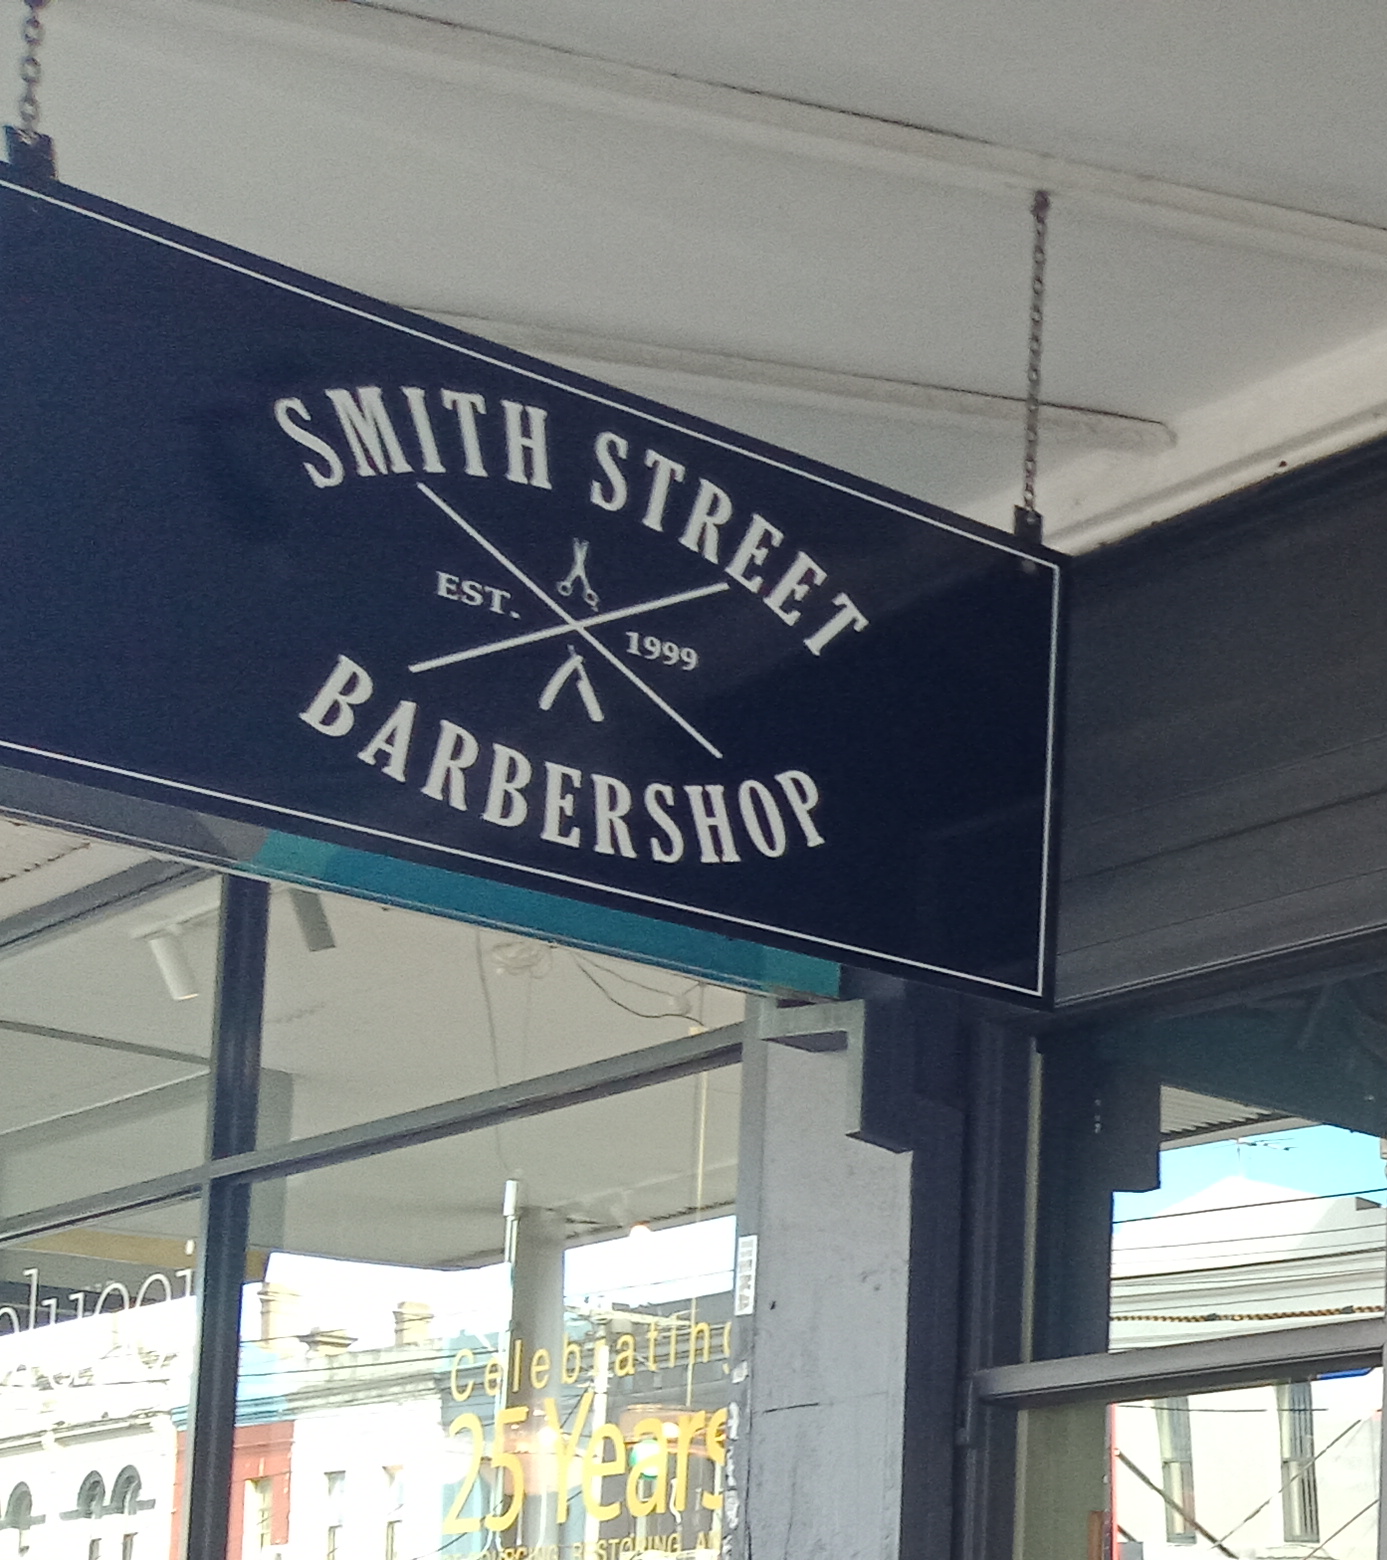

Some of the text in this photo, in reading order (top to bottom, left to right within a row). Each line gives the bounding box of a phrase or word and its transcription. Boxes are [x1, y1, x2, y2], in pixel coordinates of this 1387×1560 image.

[274, 386, 869, 656] SMITH STREET
[435, 571, 699, 670] EST. 1999
[299, 654, 825, 864] BARBERSHOP
[443, 1406, 529, 1535] 25
